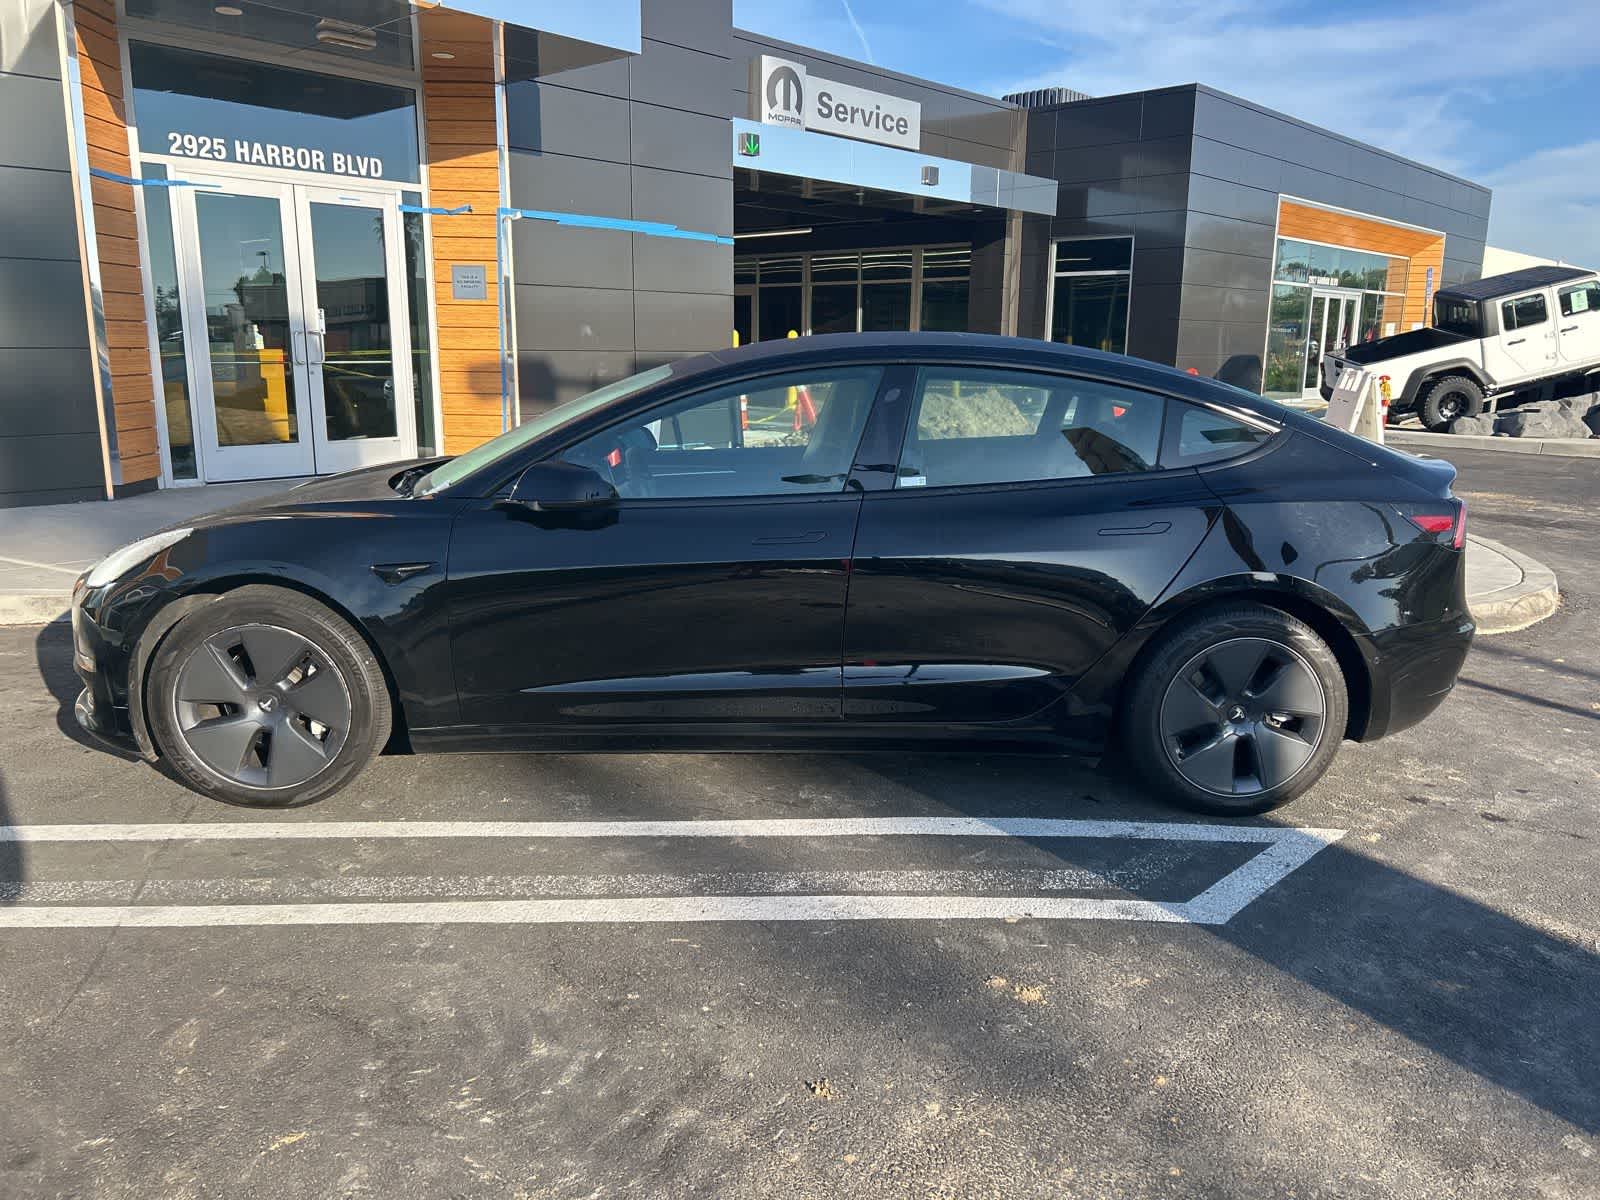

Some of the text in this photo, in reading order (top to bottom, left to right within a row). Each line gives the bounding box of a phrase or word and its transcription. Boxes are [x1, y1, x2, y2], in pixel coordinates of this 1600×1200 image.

[768, 112, 801, 126] MOPAR
[817, 91, 909, 135] Service
[168, 132, 383, 178] 2925 HARBOR BLVD
